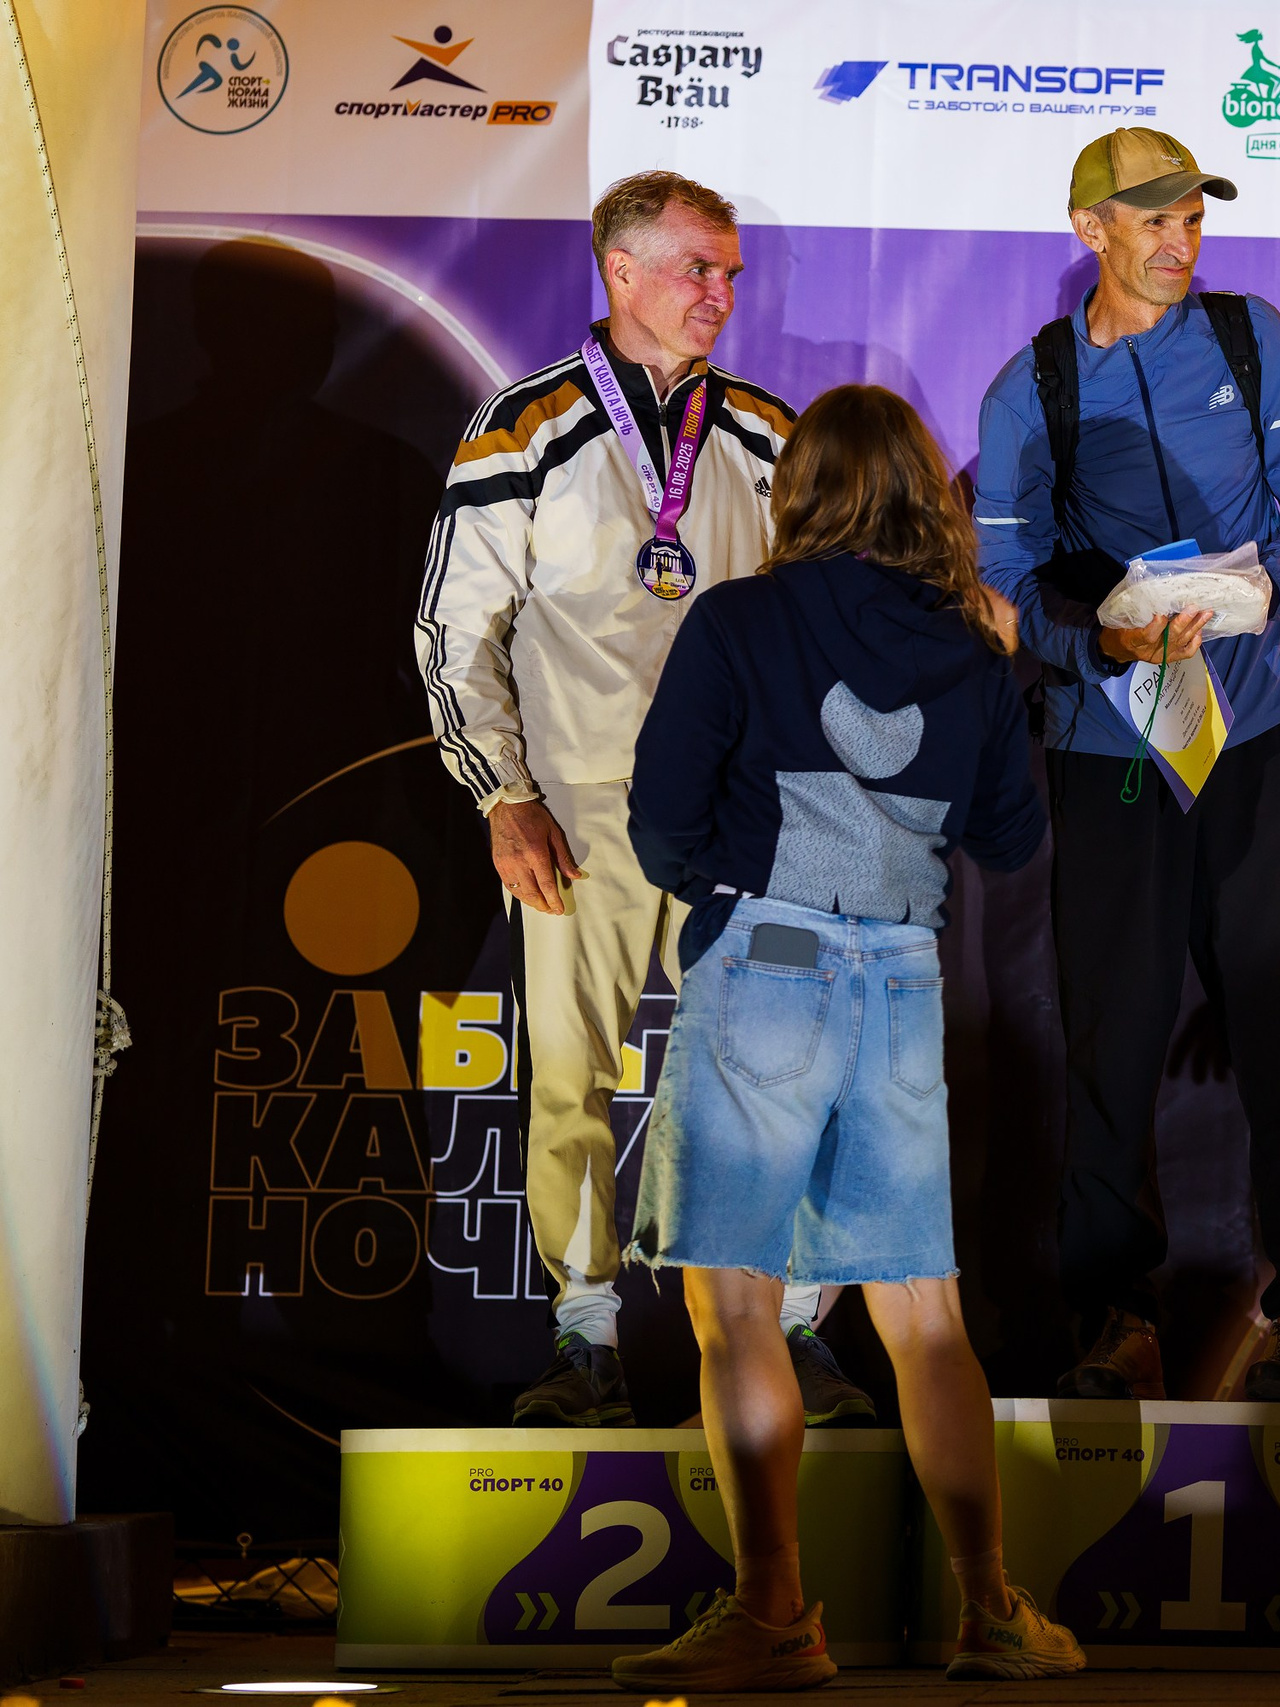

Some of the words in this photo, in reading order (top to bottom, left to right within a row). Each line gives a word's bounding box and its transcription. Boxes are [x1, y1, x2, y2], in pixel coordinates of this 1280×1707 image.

[606, 35, 763, 78] Caspary
[228, 77, 262, 86] СПОРТ
[228, 87, 269, 97] НОРМА
[636, 75, 730, 108] Bräu
[898, 62, 1165, 96] TRANSOFF
[227, 98, 268, 108] ЖИЗНИ
[493, 104, 551, 122] PRO
[907, 100, 919, 110] С
[924, 100, 1007, 112] ЗАБОТОЙ
[1012, 103, 1025, 113] О
[1030, 103, 1095, 115] ВАШЕМ
[1099, 105, 1156, 116] ГРУЗЕ
[1251, 140, 1276, 151] ДНЯ
[593, 364, 621, 407] КАЛУГА
[611, 405, 634, 436] НОЧЬ
[668, 441, 694, 500] 16.08.2025
[682, 411, 700, 439] ТВОЯ
[641, 464, 658, 495] СПОРТ
[205, 1195, 550, 1300] НОЧ
[1055, 1447, 1119, 1462] СПОРТ
[1121, 1448, 1145, 1462] 40
[469, 1468, 494, 1477] PRO
[469, 1477, 536, 1492] СПОРТ
[538, 1477, 564, 1492] 40
[574, 1500, 671, 1630] 2
[1160, 1480, 1247, 1631] 1
[771, 1632, 815, 1659] HOKA
